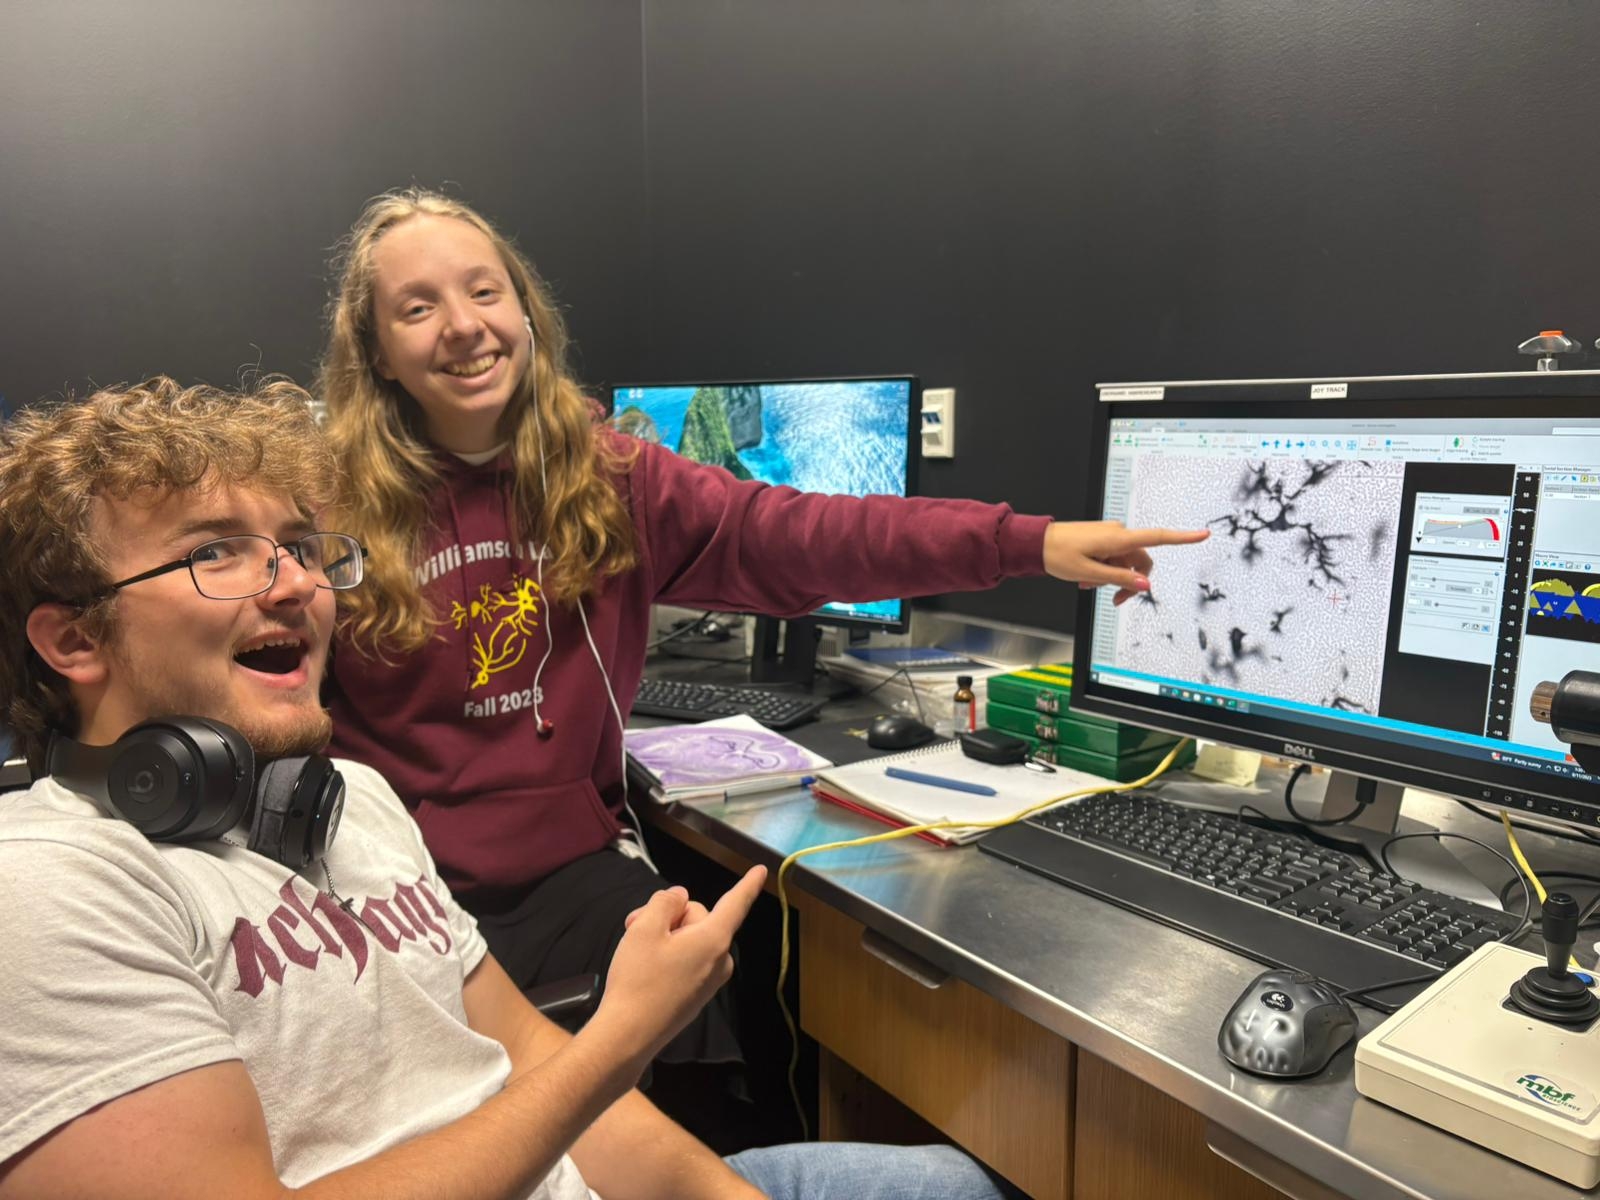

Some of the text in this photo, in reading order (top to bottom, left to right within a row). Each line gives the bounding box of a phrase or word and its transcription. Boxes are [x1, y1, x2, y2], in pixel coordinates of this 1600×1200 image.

[464, 687, 544, 718] Fall 2023
[1284, 743, 1316, 760] DELL
[1516, 1077, 1576, 1102] mbf
